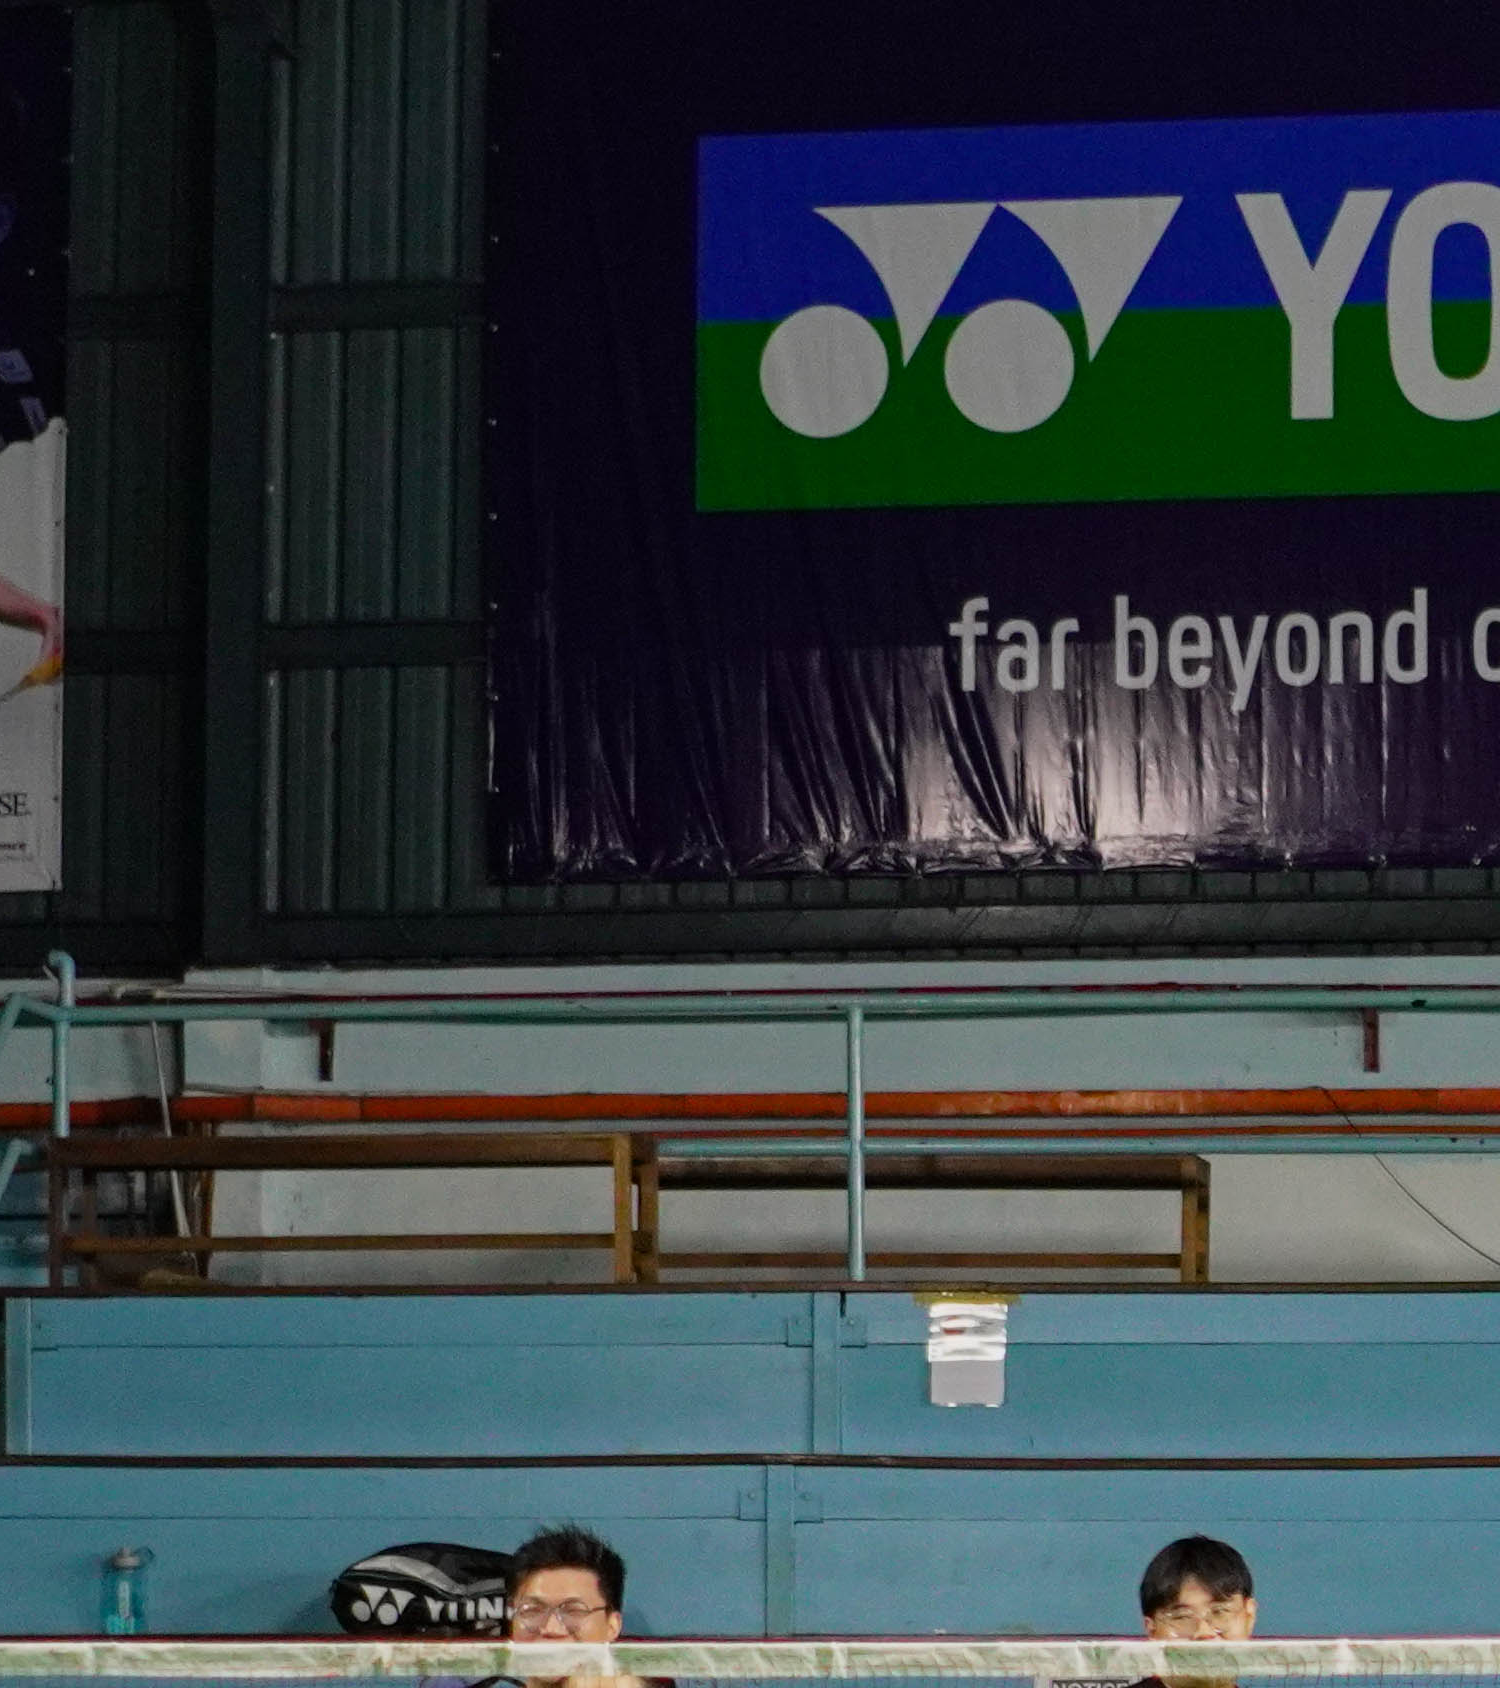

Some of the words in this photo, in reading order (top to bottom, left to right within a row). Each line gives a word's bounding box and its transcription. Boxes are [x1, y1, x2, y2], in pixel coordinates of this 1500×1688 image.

[948, 597, 1079, 695] far
[1115, 588, 1430, 712] beyond
[424, 1595, 513, 1623] YON
